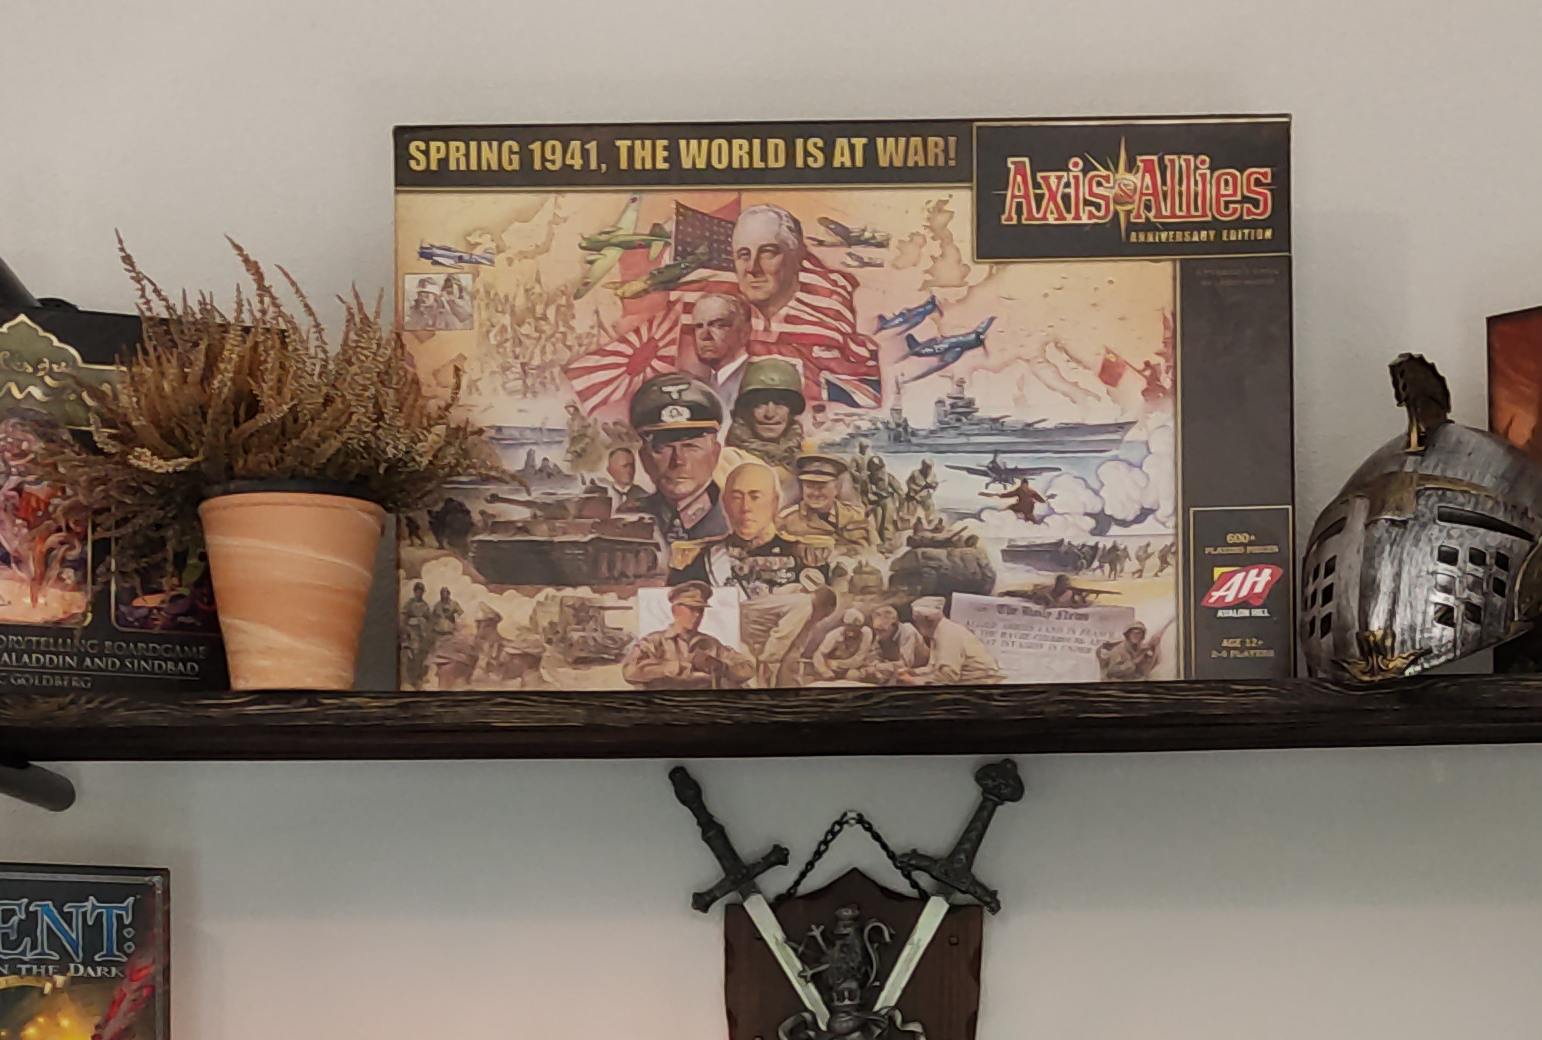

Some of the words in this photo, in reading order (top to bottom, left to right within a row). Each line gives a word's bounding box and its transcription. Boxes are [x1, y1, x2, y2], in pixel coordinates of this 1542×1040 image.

[408, 140, 520, 172] SPRING
[527, 139, 608, 174] 1941,
[614, 138, 670, 171] THE
[677, 137, 787, 170] WORLD
[794, 137, 825, 169] IS
[831, 137, 869, 169] AT
[875, 136, 958, 168] WAR!
[1000, 155, 1114, 225] Axis
[1130, 153, 1274, 224] Allies
[1128, 229, 1217, 244] ANNIVERSARY
[1221, 227, 1274, 241] EDITION
[1207, 567, 1274, 604] AH
[104, 641, 207, 660] BOARDGAME
[1221, 638, 1242, 648] AGE
[0, 650, 77, 669] ALADDIN
[81, 656, 121, 672] AND
[124, 658, 200, 675] SINDBAD
[16, 963, 60, 978] THE
[67, 962, 126, 979] DARK
